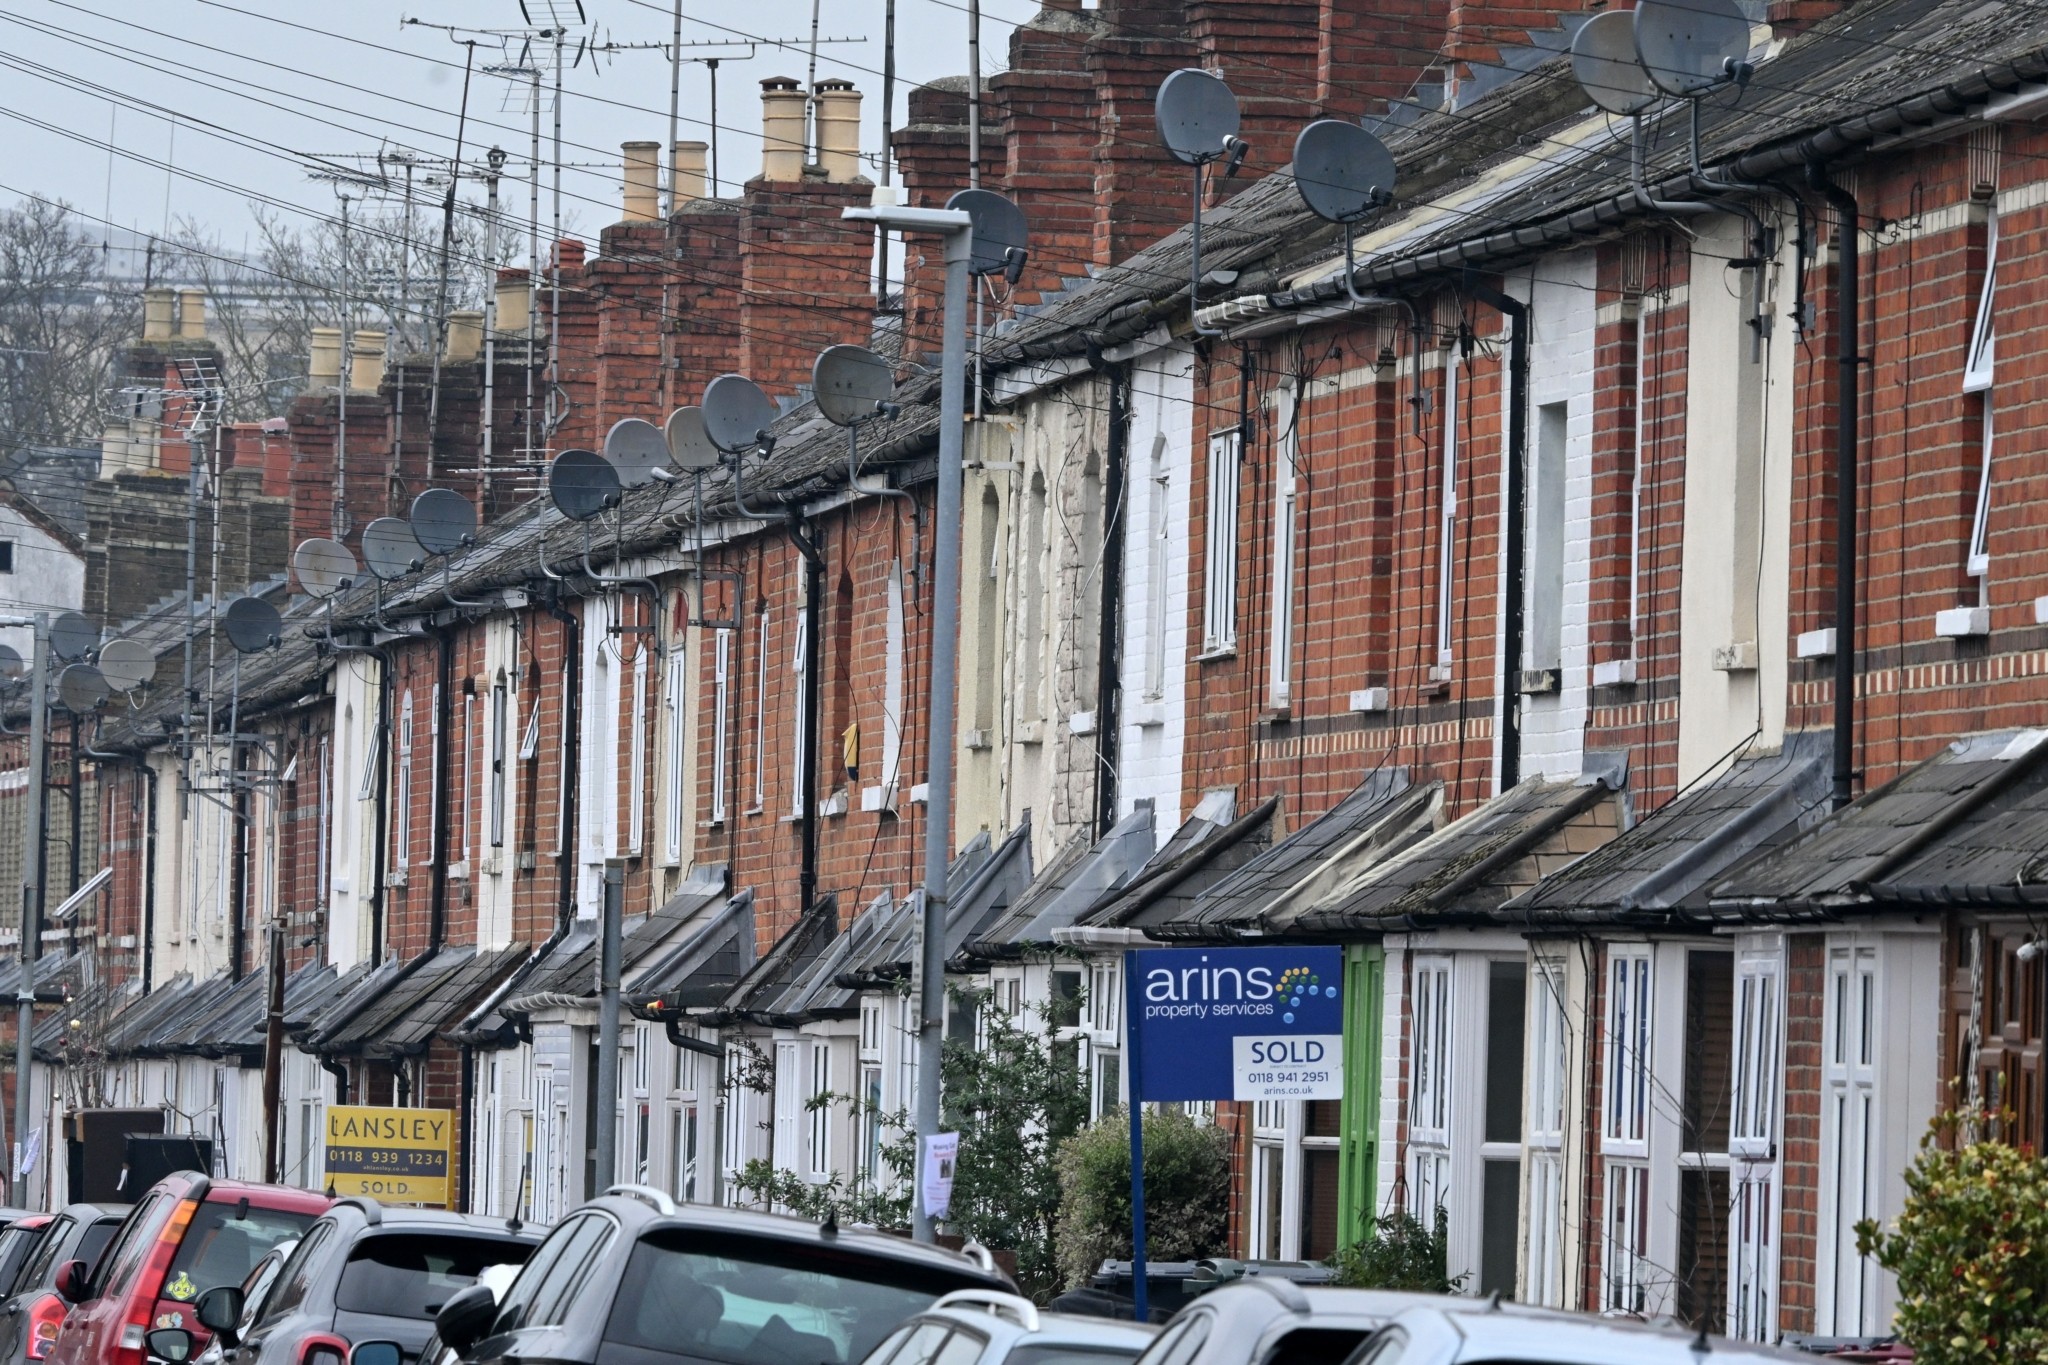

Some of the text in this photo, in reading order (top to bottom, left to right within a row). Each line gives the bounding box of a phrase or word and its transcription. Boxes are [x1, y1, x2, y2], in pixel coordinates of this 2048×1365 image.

[1145, 956, 1274, 1001] arins
[1146, 1001, 1274, 1019] property services
[1251, 1041, 1324, 1064] SOLD
[1248, 1072, 1329, 1083] 0118 941 2951
[1264, 1086, 1313, 1095] arins.co.uk
[331, 1115, 444, 1140] LANSLEY
[330, 1150, 442, 1165] 0118 939 1234
[361, 1181, 408, 1195] SOLD
